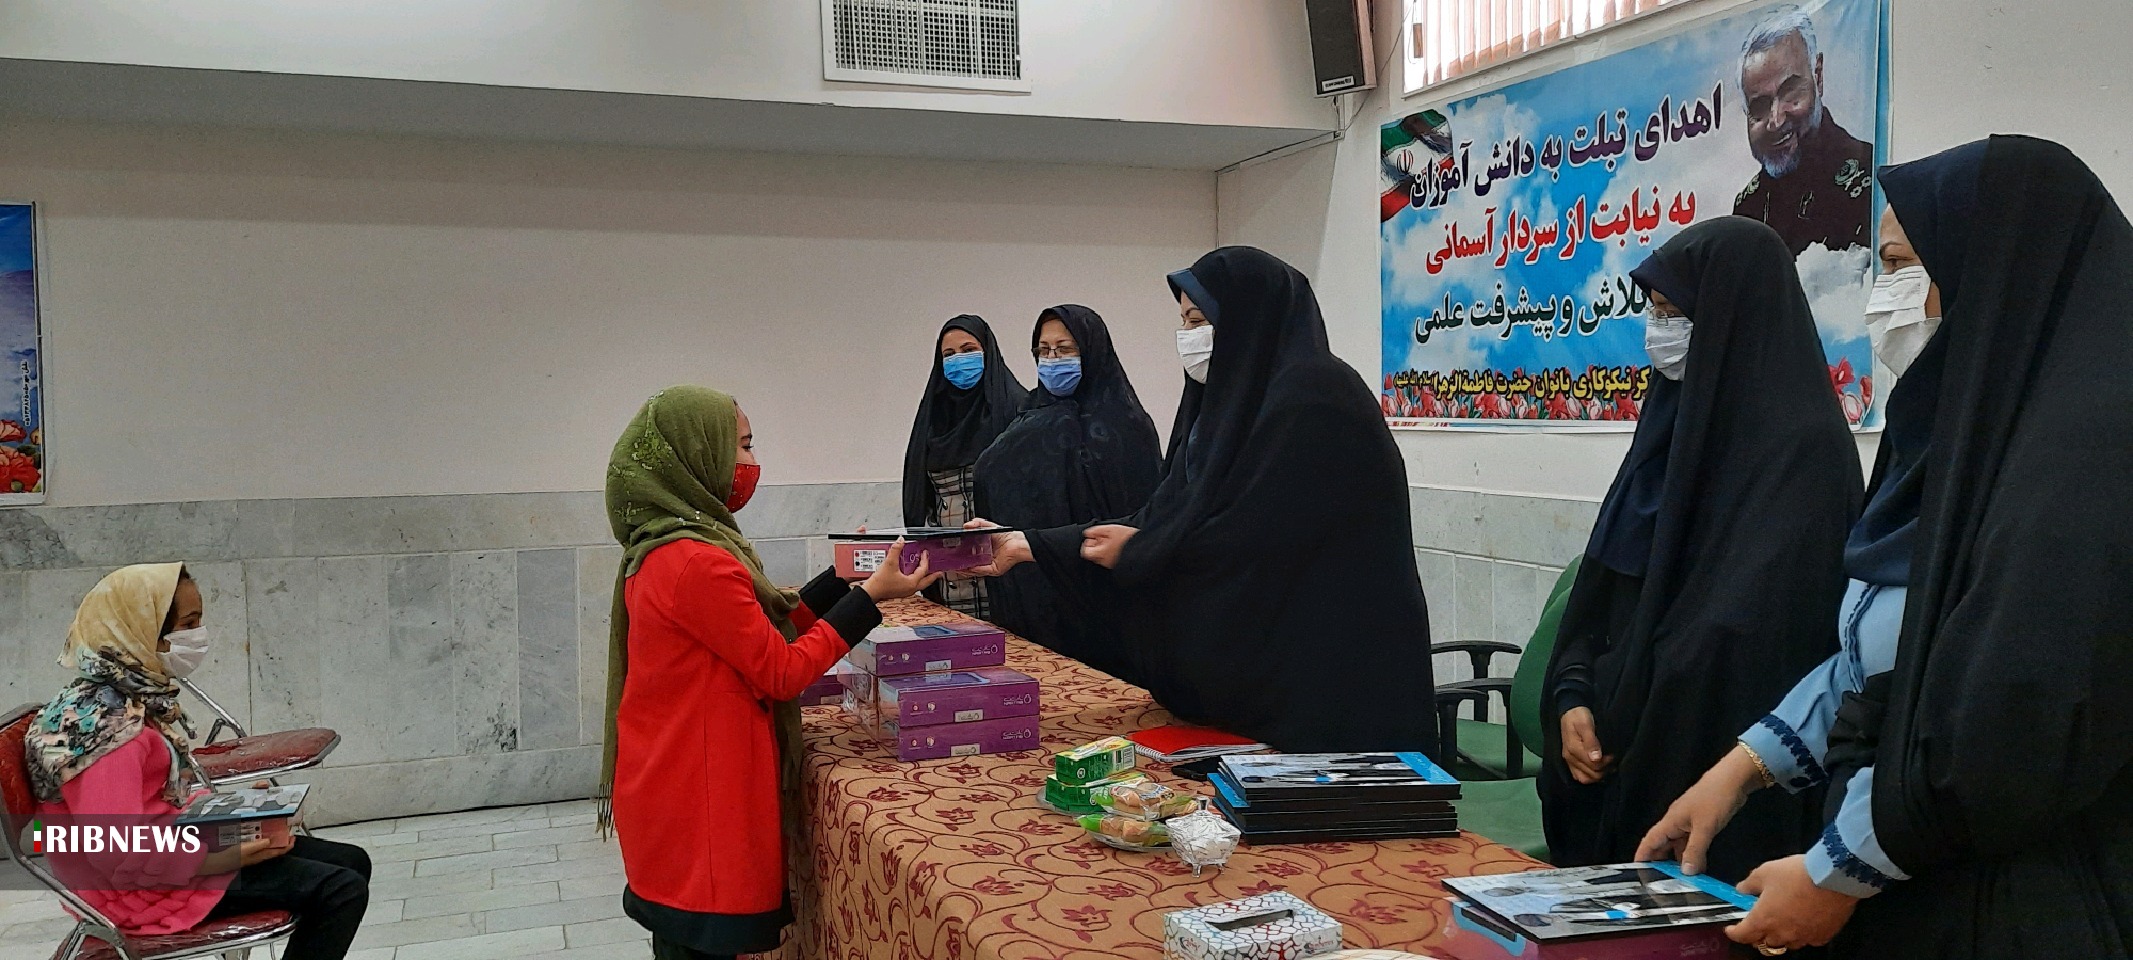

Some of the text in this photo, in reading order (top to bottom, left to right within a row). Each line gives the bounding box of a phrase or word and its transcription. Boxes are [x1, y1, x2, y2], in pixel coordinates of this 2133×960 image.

[1410, 82, 1722, 207] اهدای تبلت به دانش آموزان
[1426, 207, 1497, 274] آسمانی
[1495, 211, 1558, 268] سردار
[1560, 197, 1585, 258] از
[1591, 186, 1661, 247] نیابت
[1416, 294, 1463, 342] علمی
[1471, 284, 1557, 339] پیشرفت
[1559, 297, 1574, 335] و
[1496, 371, 1532, 400] حضرت
[1535, 367, 1571, 400] بانوان
[1573, 365, 1632, 400] نیکوکاری
